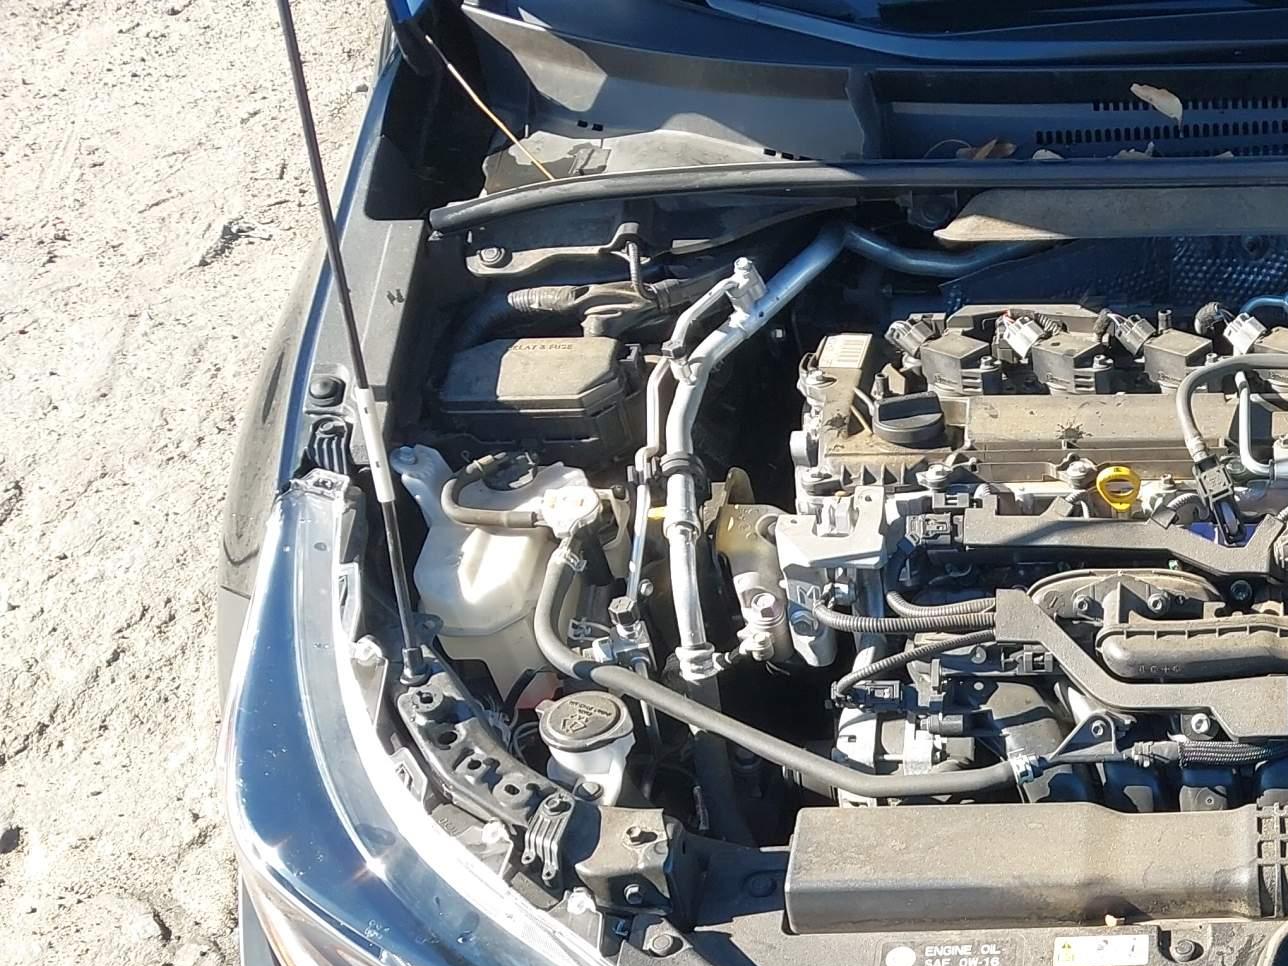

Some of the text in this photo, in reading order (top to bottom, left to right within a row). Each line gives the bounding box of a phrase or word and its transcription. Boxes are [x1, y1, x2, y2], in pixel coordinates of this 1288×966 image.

[549, 342, 574, 350] FUSE
[925, 944, 1001, 957] ENGINE OIL
